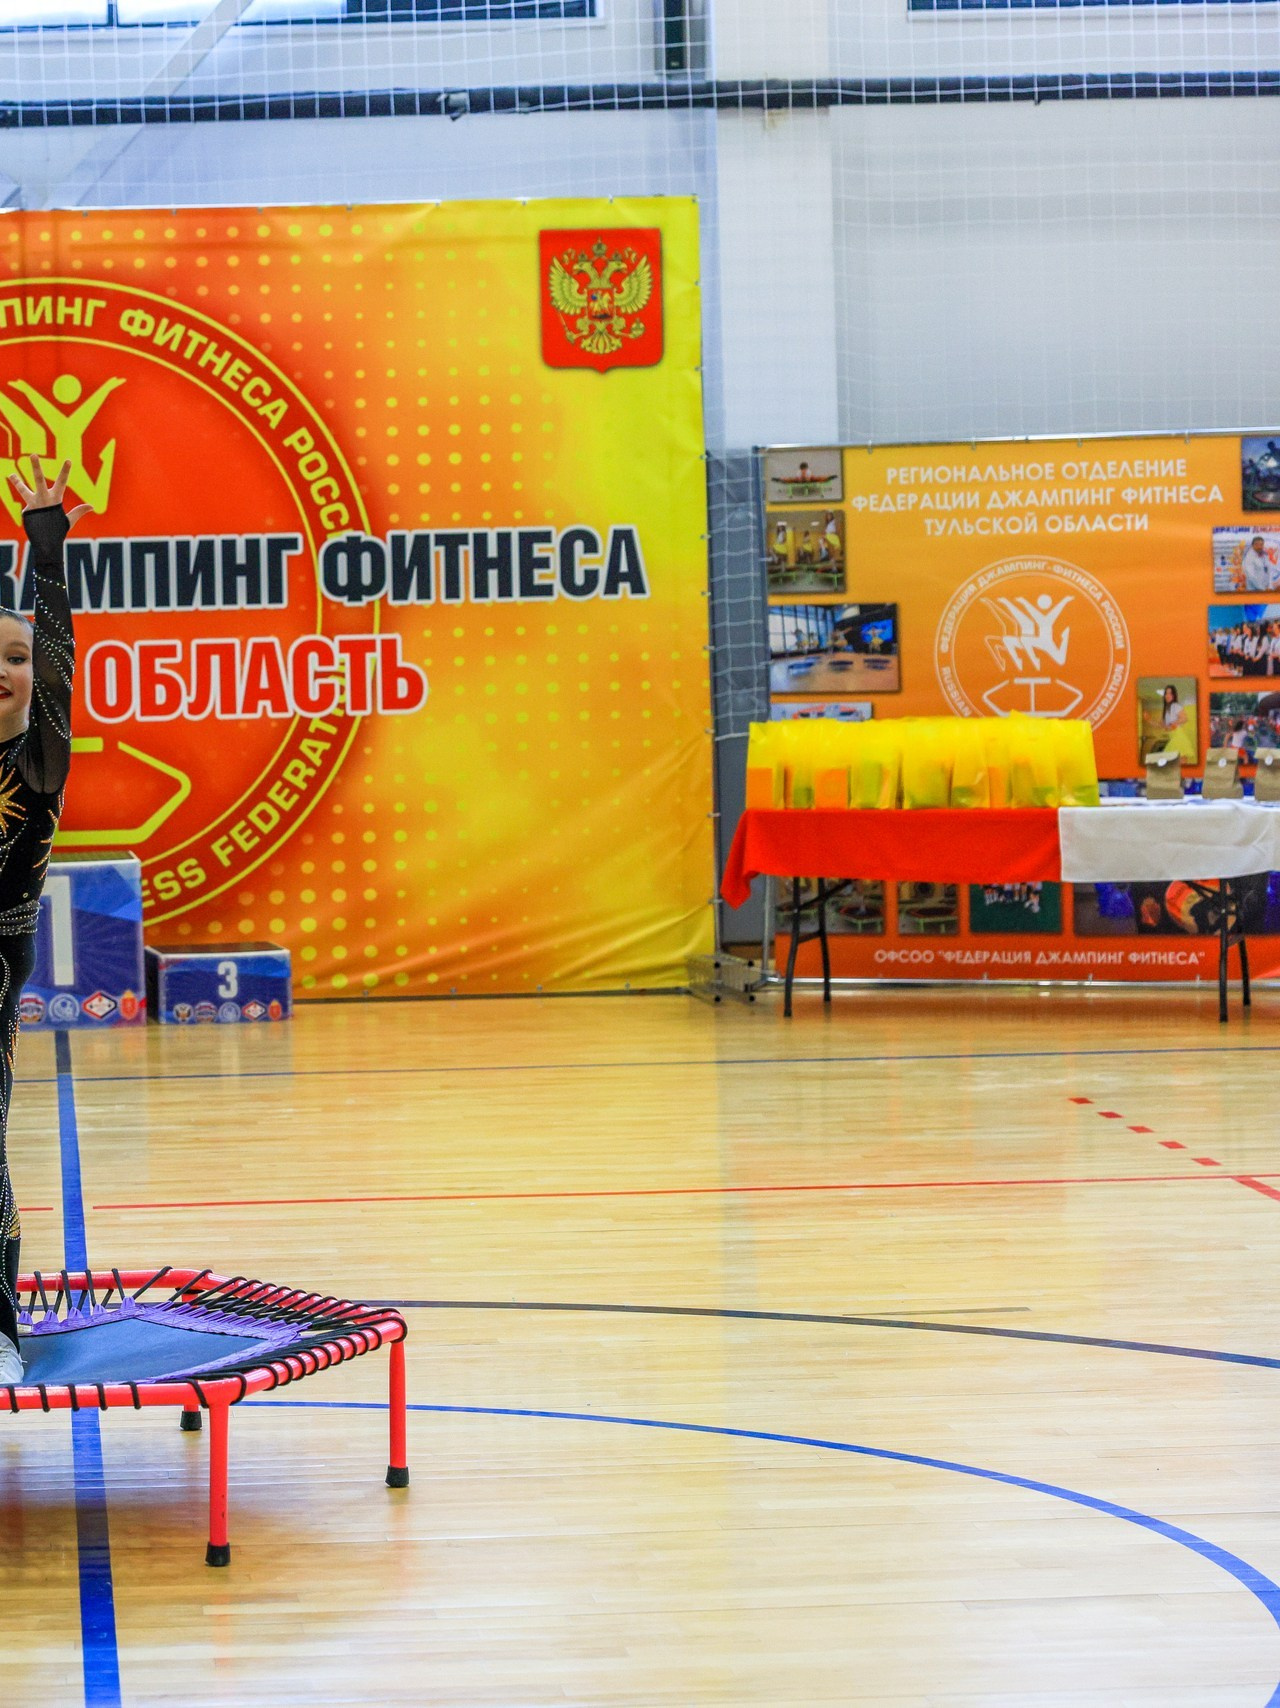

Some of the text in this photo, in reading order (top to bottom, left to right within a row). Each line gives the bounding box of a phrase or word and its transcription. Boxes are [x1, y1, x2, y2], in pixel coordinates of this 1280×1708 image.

[119, 308, 289, 430] ФИТНЕСА
[283, 426, 354, 540] РОСС
[886, 459, 1187, 486] РЕГИОНАЛЬНОЕ ОТДЕЛЕНИЕ
[851, 484, 1223, 514] ФЕДЕРАЦИИ ДЖАМПИНГ ФИТНЕСА
[924, 512, 1149, 536] ТУЛЬСКОЙ ОБЛАСТИ
[320, 524, 650, 606] ФИТНЕСА
[85, 633, 428, 724] ОБЛАСТЬ
[40, 875, 74, 986] 1
[874, 950, 934, 964] ОФСОО
[1035, 951, 1124, 965] ДЖАМПИНГ
[218, 961, 239, 998] 3
